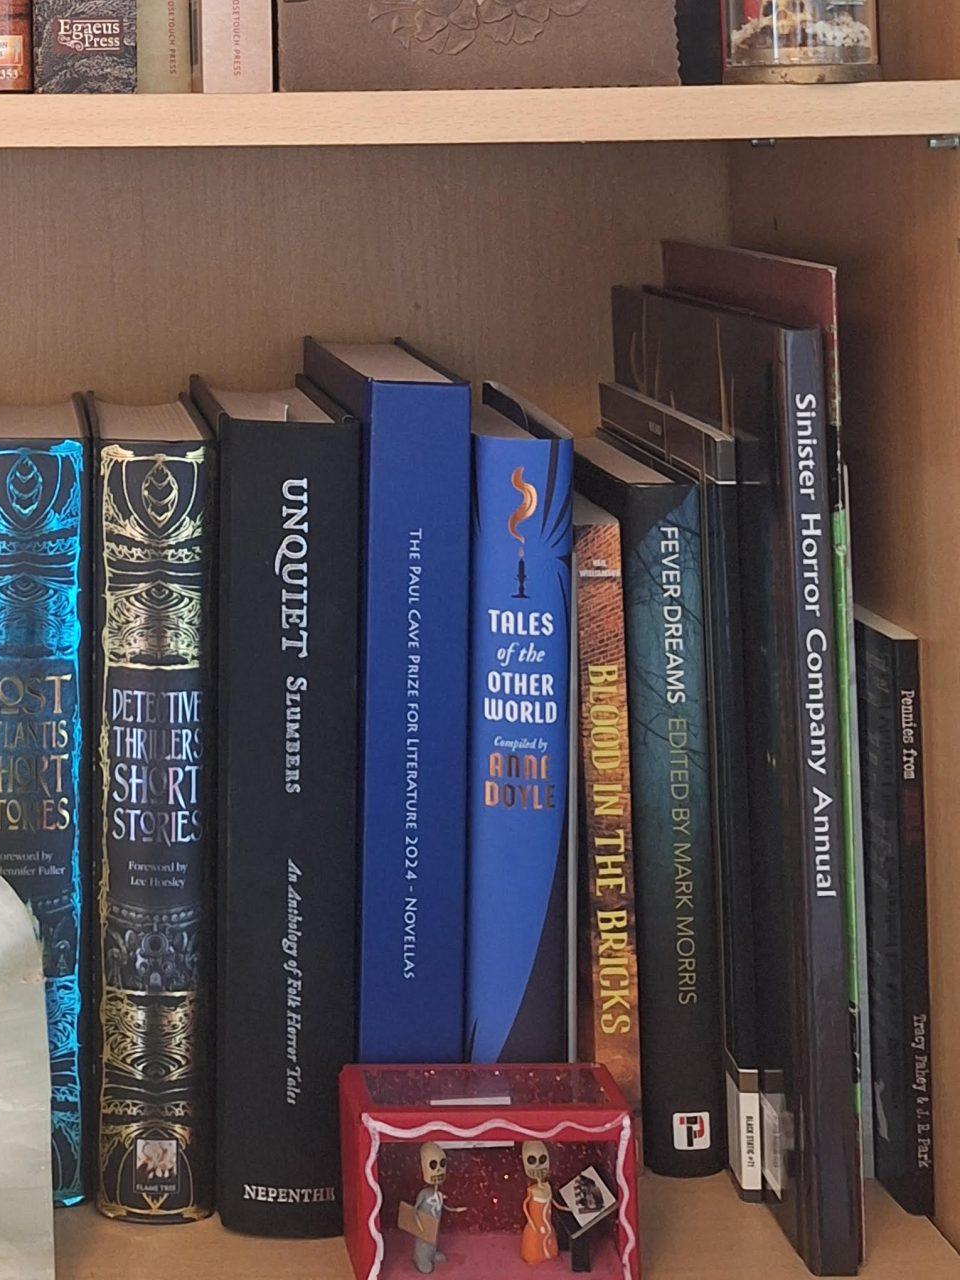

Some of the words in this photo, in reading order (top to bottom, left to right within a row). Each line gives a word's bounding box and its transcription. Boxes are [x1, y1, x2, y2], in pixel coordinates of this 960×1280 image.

[58, 19, 120, 39] Egaeus
[794, 392, 818, 501] Sinister
[274, 477, 309, 658] UNQUIET
[407, 565, 422, 605] PAUL
[660, 526, 681, 599] FEVER
[800, 512, 822, 618] Horror
[407, 609, 422, 649] CAVE
[488, 609, 554, 637] TALES
[663, 605, 686, 704] DREAMS
[407, 654, 421, 697] PRIZE
[487, 670, 555, 697] OTHER
[805, 627, 827, 775] Company
[482, 696, 558, 725] WORLD
[587, 663, 621, 773] BLOOD
[900, 689, 916, 745] Pennies
[405, 737, 421, 830] LITERATURE
[668, 718, 690, 801] EDITED
[483, 780, 557, 810] DOYLE
[592, 782, 624, 817] IN
[128, 860, 175, 872] Foreword
[405, 835, 419, 880] 2024
[593, 828, 626, 896] THE
[672, 841, 695, 909] MARK
[812, 786, 837, 898] Annual
[281, 884, 302, 958] Anthology
[403, 896, 419, 980] NOVELLAS
[596, 909, 631, 1035] BRICKS
[676, 915, 697, 1006] MORRIS
[911, 1014, 927, 1050] Tracy
[918, 1138, 931, 1168] Park
